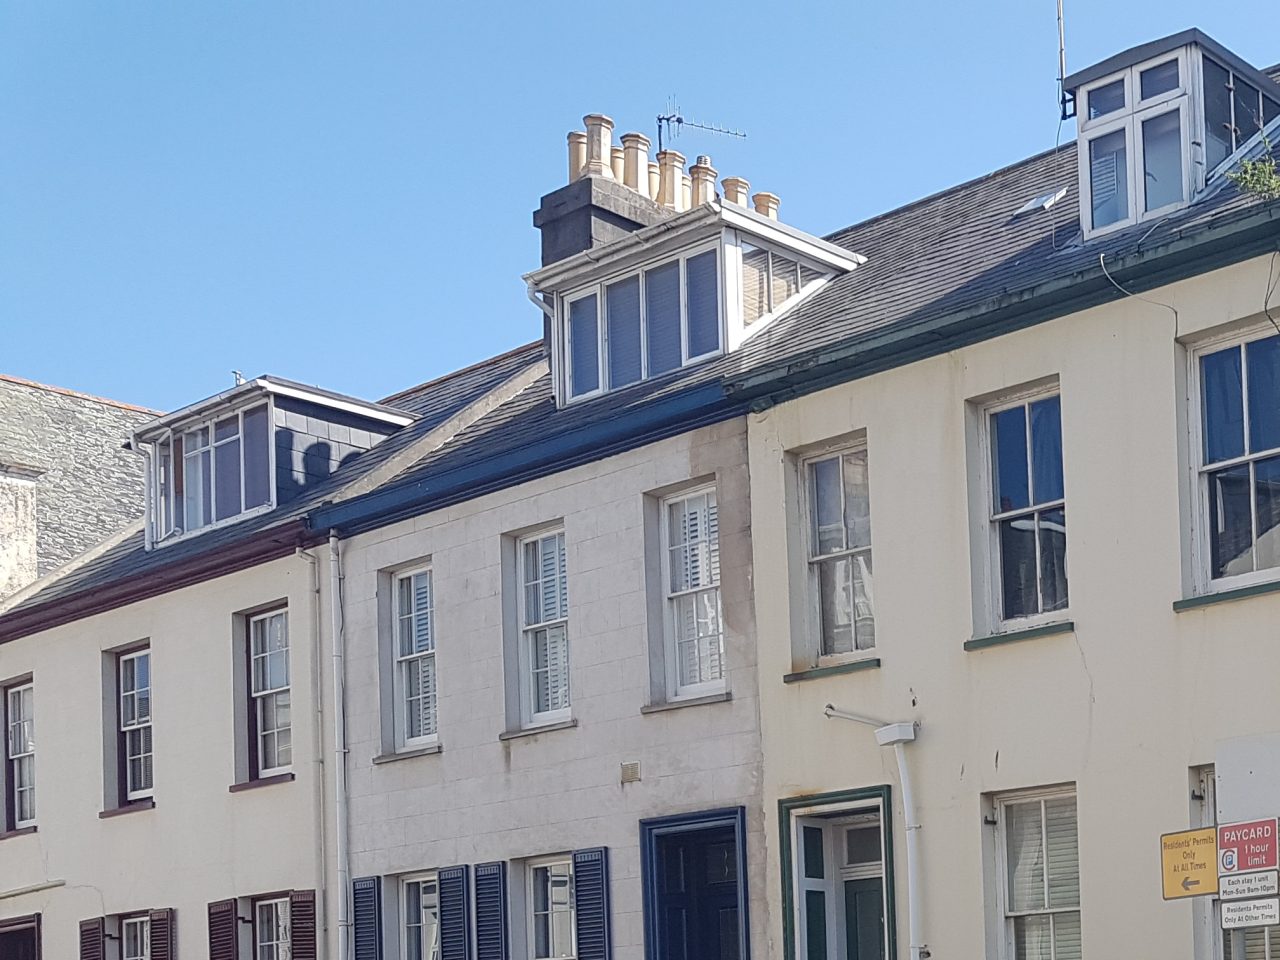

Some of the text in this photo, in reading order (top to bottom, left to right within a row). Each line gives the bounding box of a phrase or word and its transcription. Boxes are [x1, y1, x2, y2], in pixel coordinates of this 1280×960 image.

[1224, 825, 1271, 843] PAYCARD
[1193, 836, 1214, 846] Permits
[1251, 843, 1269, 854] hour
[1182, 850, 1196, 860] Only
[1248, 855, 1266, 866] limit
[1173, 861, 1207, 873] At All Times
[1227, 877, 1241, 886] Each
[1241, 877, 1253, 886] stay
[1222, 887, 1246, 897] Mon-Sun
[1253, 903, 1273, 911] Permits
[1224, 915, 1237, 924] Only
[1244, 913, 1260, 921] Other
[1261, 912, 1276, 920] Times
